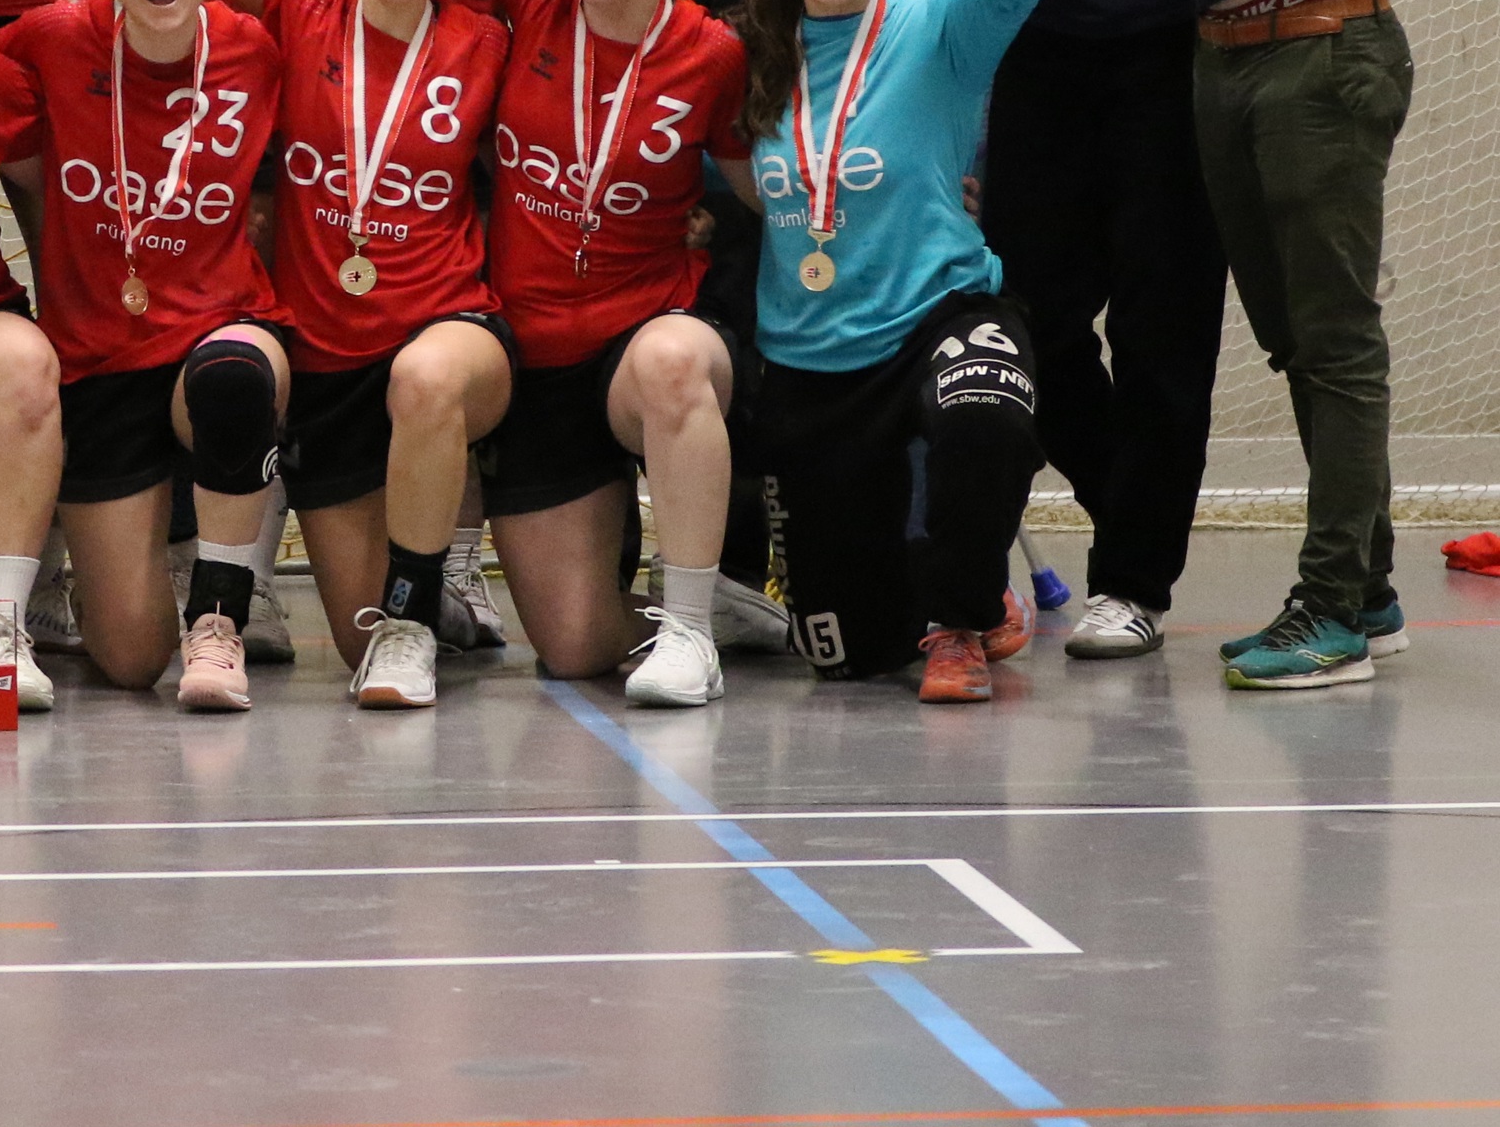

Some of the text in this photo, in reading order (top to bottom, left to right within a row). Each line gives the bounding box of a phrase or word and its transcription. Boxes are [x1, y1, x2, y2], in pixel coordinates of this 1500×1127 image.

[161, 87, 249, 157] 23
[420, 75, 462, 144] 8
[600, 91, 693, 164] 3
[60, 158, 235, 225] oase
[315, 207, 409, 242] rümang
[941, 394, 1001, 410] www.sbw.edu
[812, 620, 837, 660] 5
